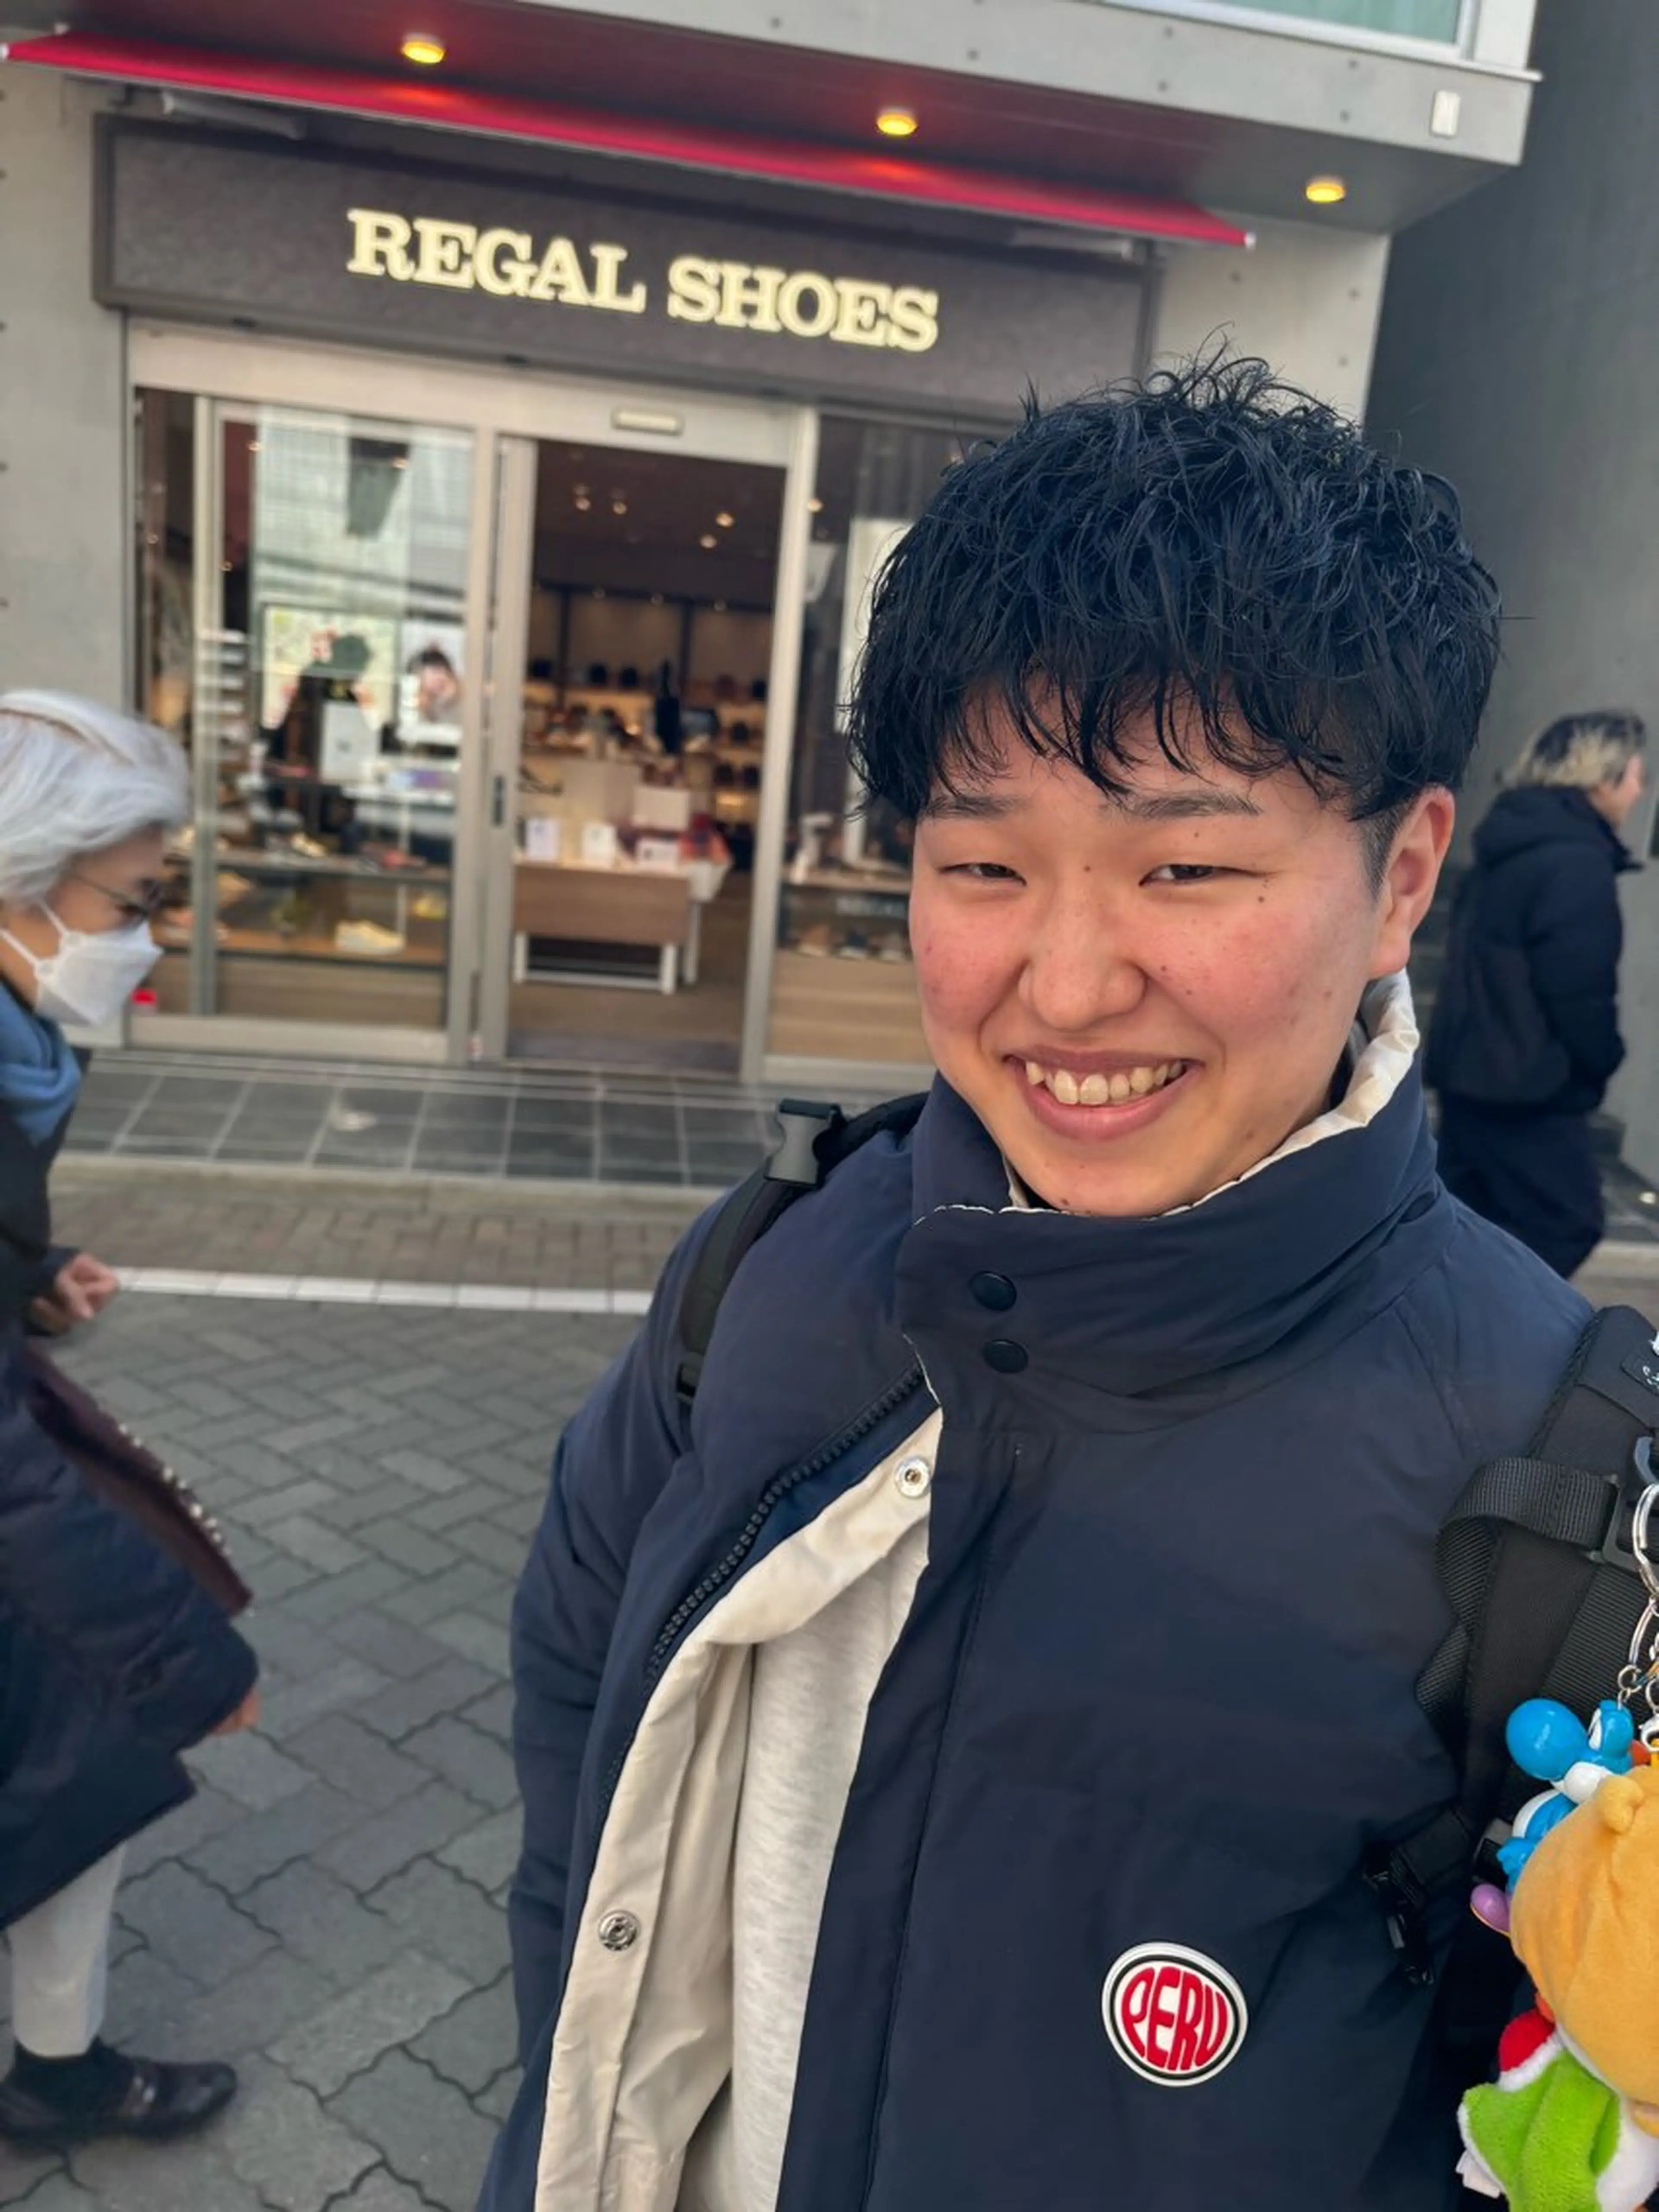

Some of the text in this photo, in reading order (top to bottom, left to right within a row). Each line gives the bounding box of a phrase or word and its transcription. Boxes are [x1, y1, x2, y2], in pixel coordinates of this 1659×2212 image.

[346, 209, 939, 352] REGAL SHOES
[1121, 1966, 1228, 2071] PERU
